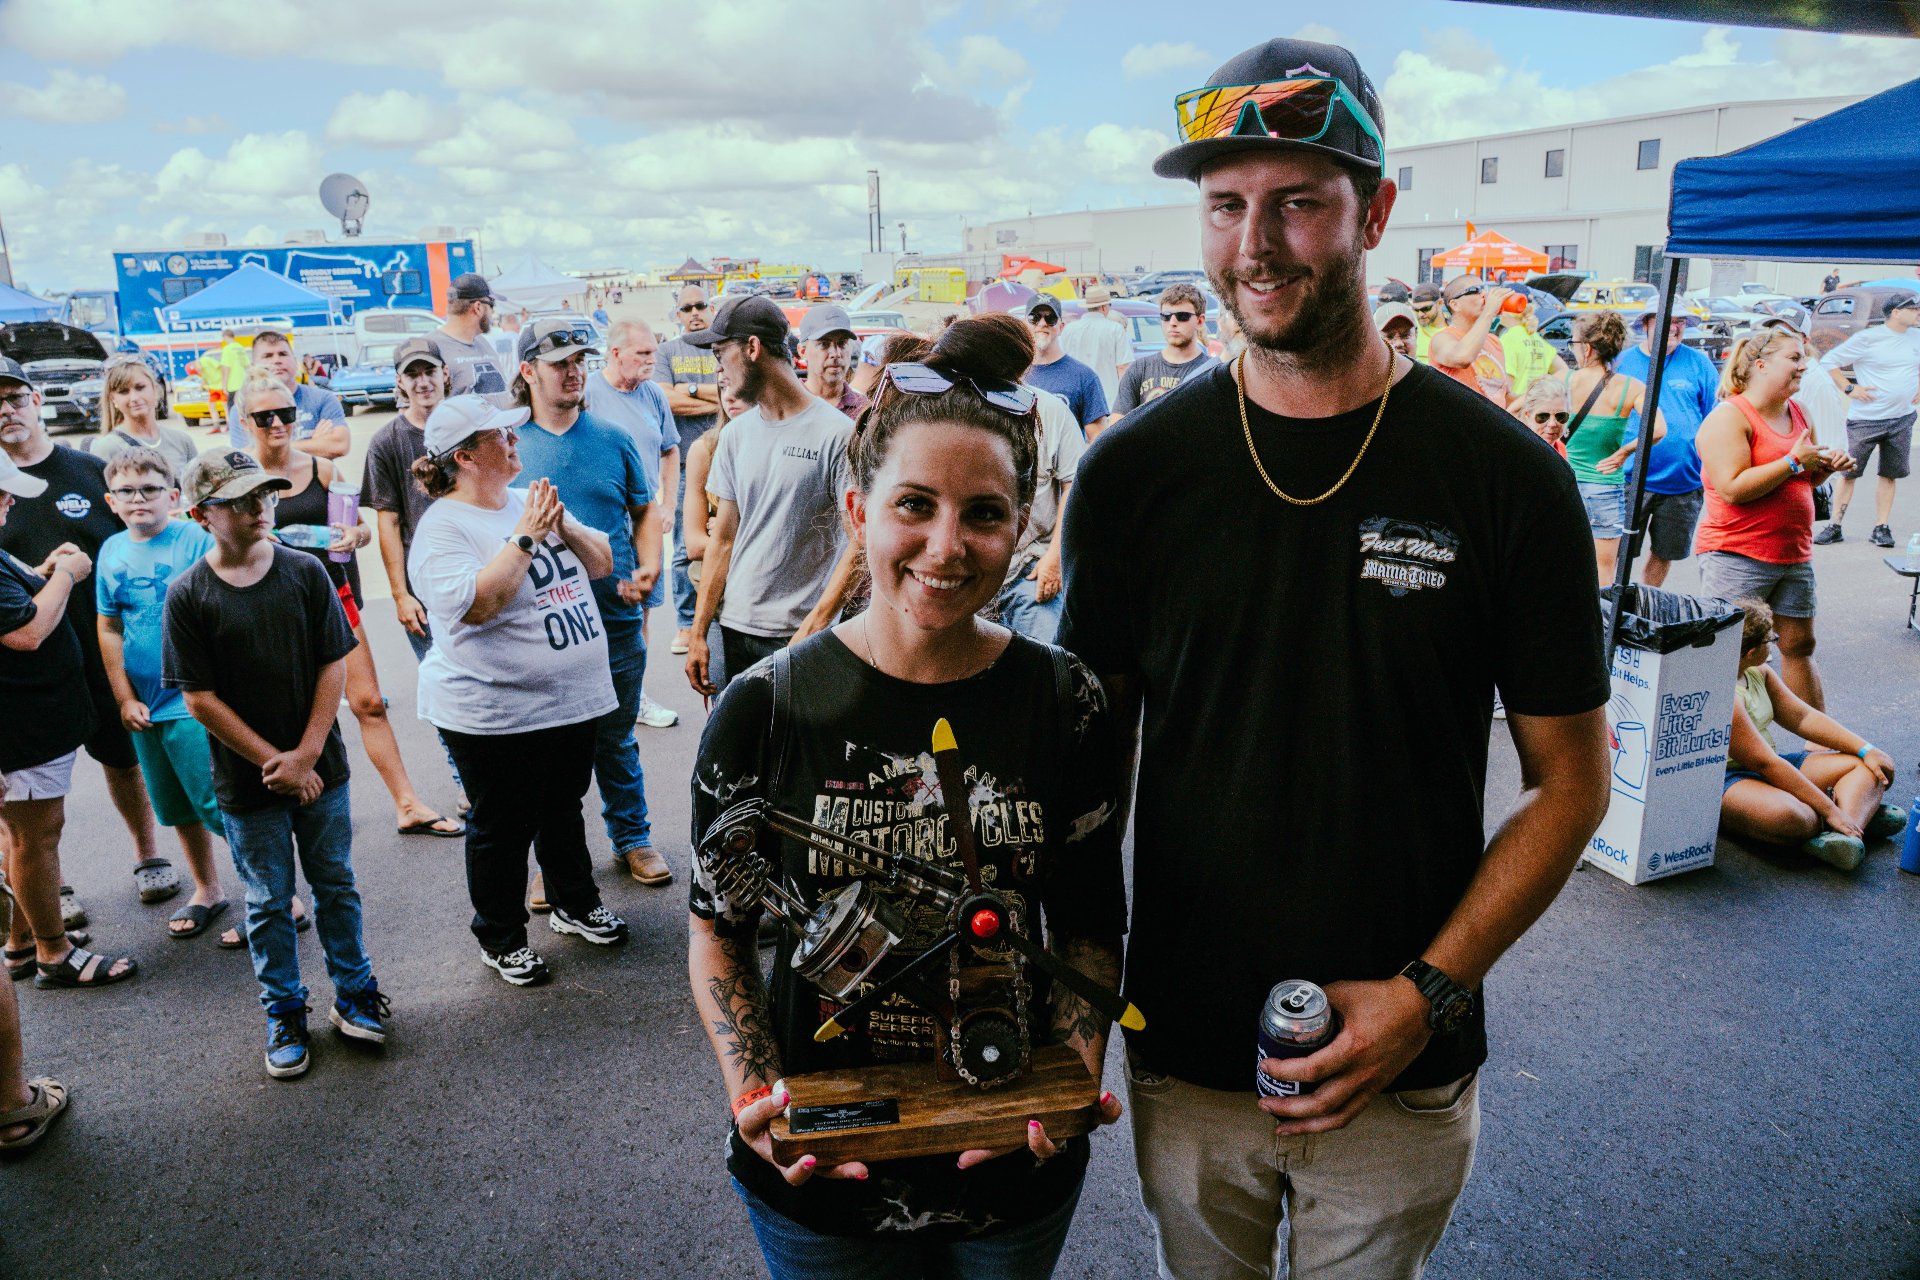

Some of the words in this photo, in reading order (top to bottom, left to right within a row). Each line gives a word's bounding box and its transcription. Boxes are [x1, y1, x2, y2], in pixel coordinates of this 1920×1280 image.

[143, 260, 161, 272] VA
[783, 446, 819, 460] WILLIAM
[56, 499, 91, 511] WELD
[1360, 533, 1405, 552] Fuel
[1406, 539, 1455, 562] Moto
[527, 539, 578, 590] BE
[546, 582, 577, 605] THE
[544, 601, 600, 651] ONE
[1623, 671, 1651, 690] Helps.
[1660, 690, 1710, 717] Every
[1657, 714, 1702, 739] Litter
[1655, 736, 1679, 761] Bit
[1655, 765, 1677, 777] Every
[1677, 760, 1695, 771] Little
[1695, 757, 1705, 768] Bit
[1592, 836, 1629, 865] tRock
[1664, 842, 1712, 864] WestRock
[816, 1123, 860, 1131] Motorcycle
